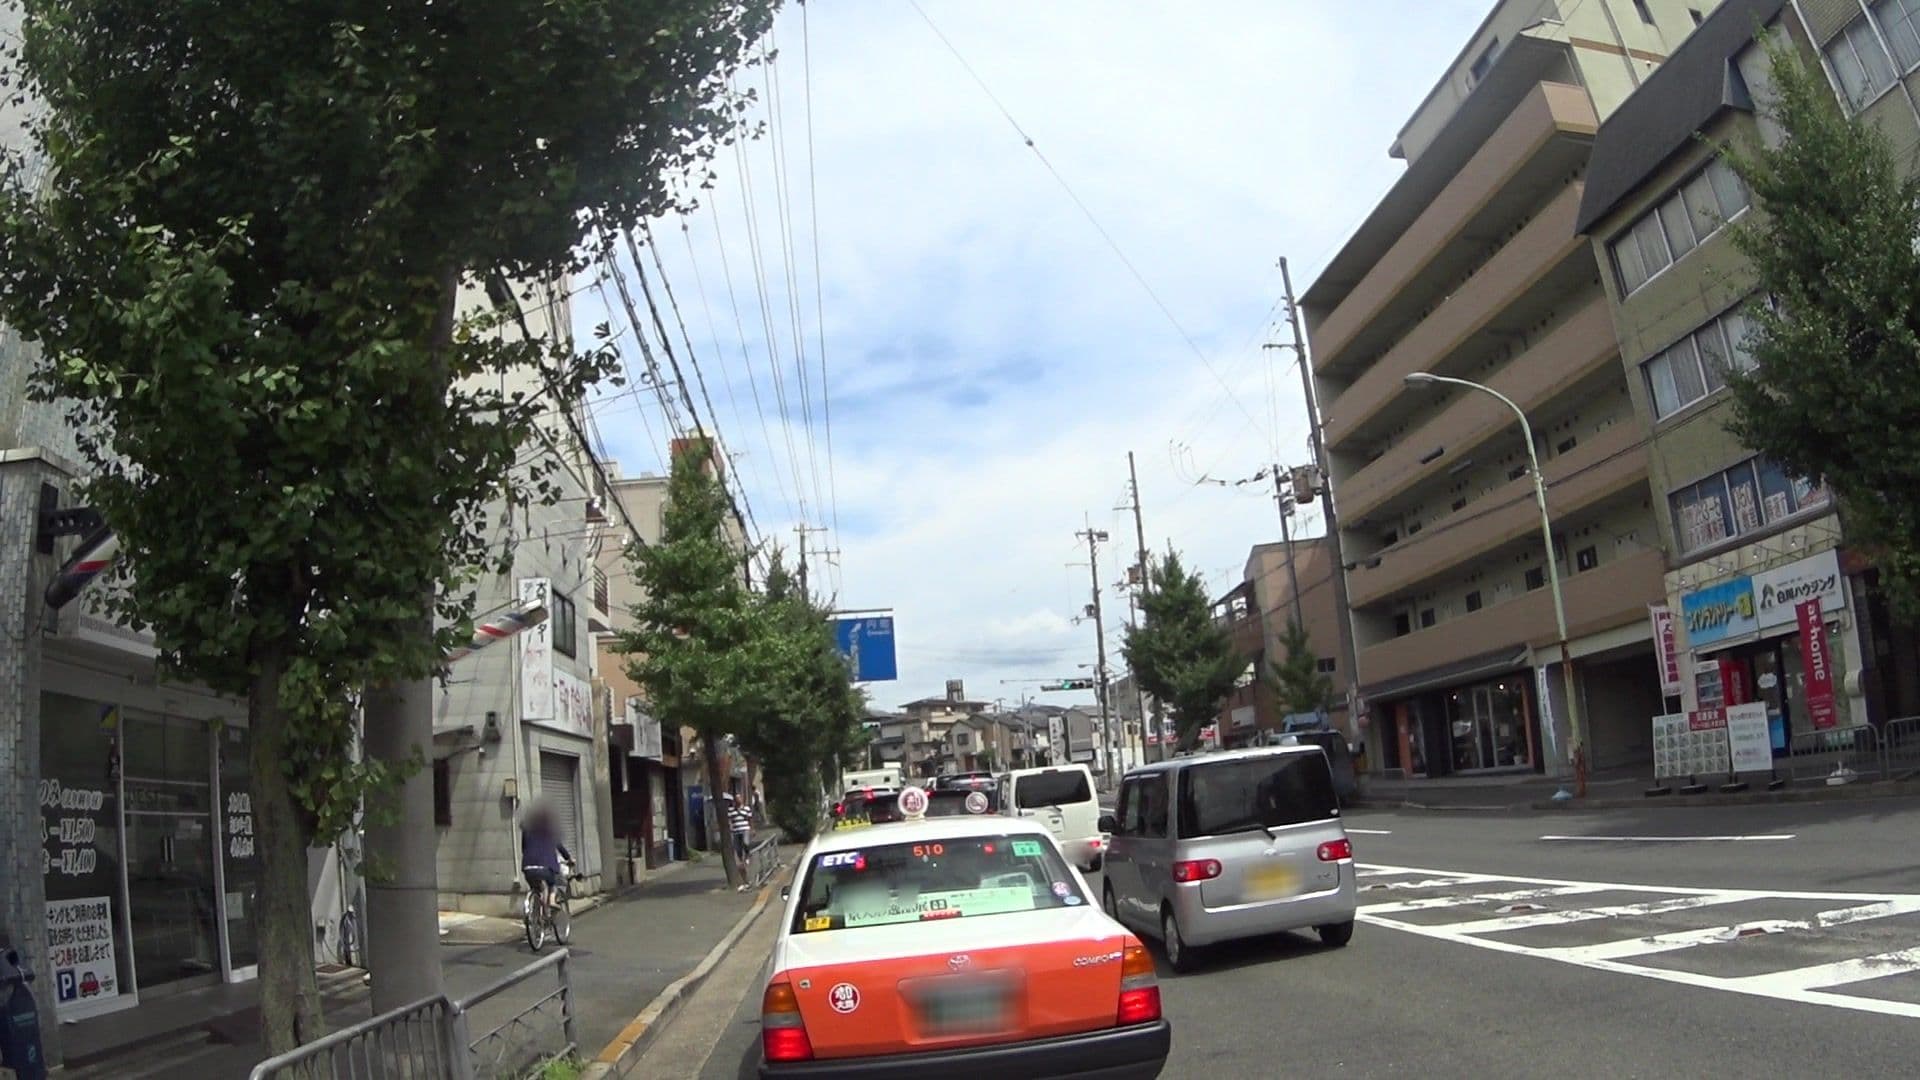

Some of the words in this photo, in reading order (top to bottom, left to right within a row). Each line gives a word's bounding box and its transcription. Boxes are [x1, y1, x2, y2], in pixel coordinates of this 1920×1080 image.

[1810, 626, 1826, 681] home
[822, 852, 857, 868] ETC
[913, 844, 944, 857] 510
[61, 972, 73, 999] P
